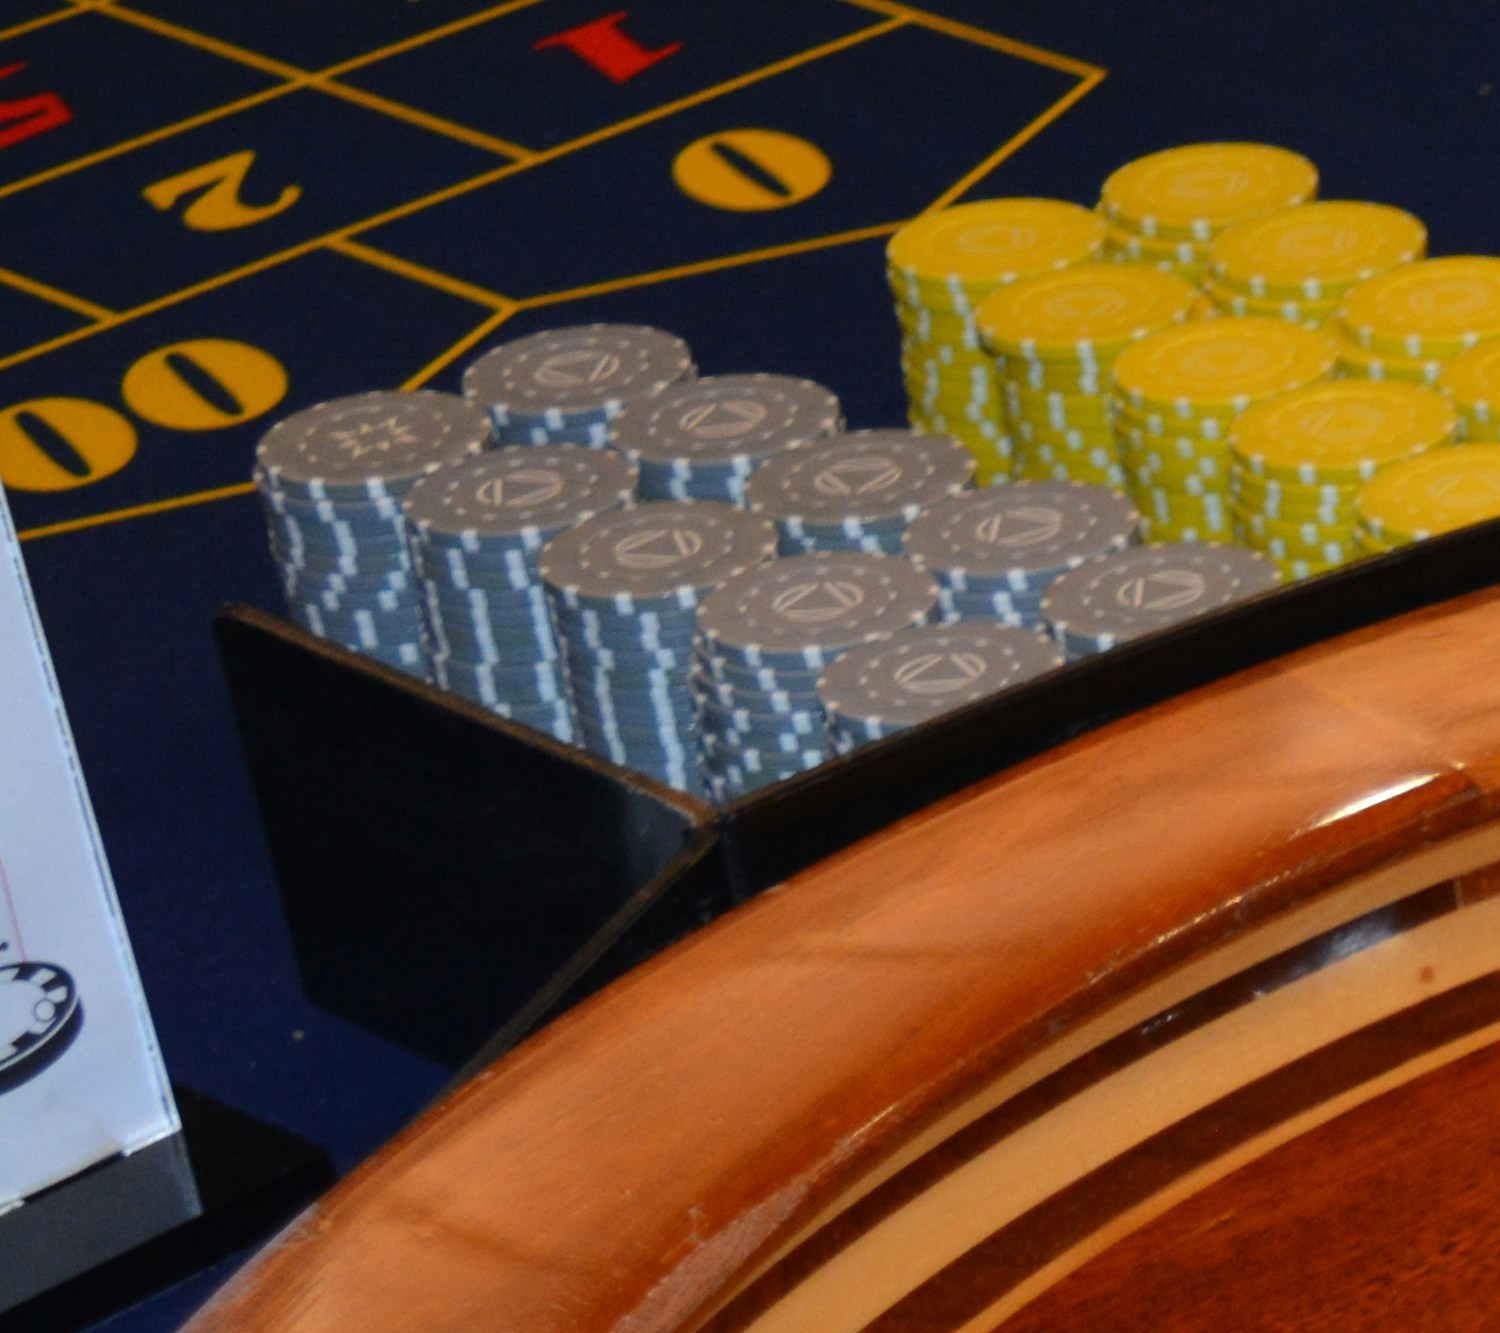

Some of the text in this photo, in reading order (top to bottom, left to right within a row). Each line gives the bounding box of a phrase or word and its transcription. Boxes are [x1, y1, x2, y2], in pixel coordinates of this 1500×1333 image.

[531, 10, 684, 84] 1
[143, 150, 302, 232] 2
[672, 128, 833, 212] 0
[0, 339, 289, 492] 00
